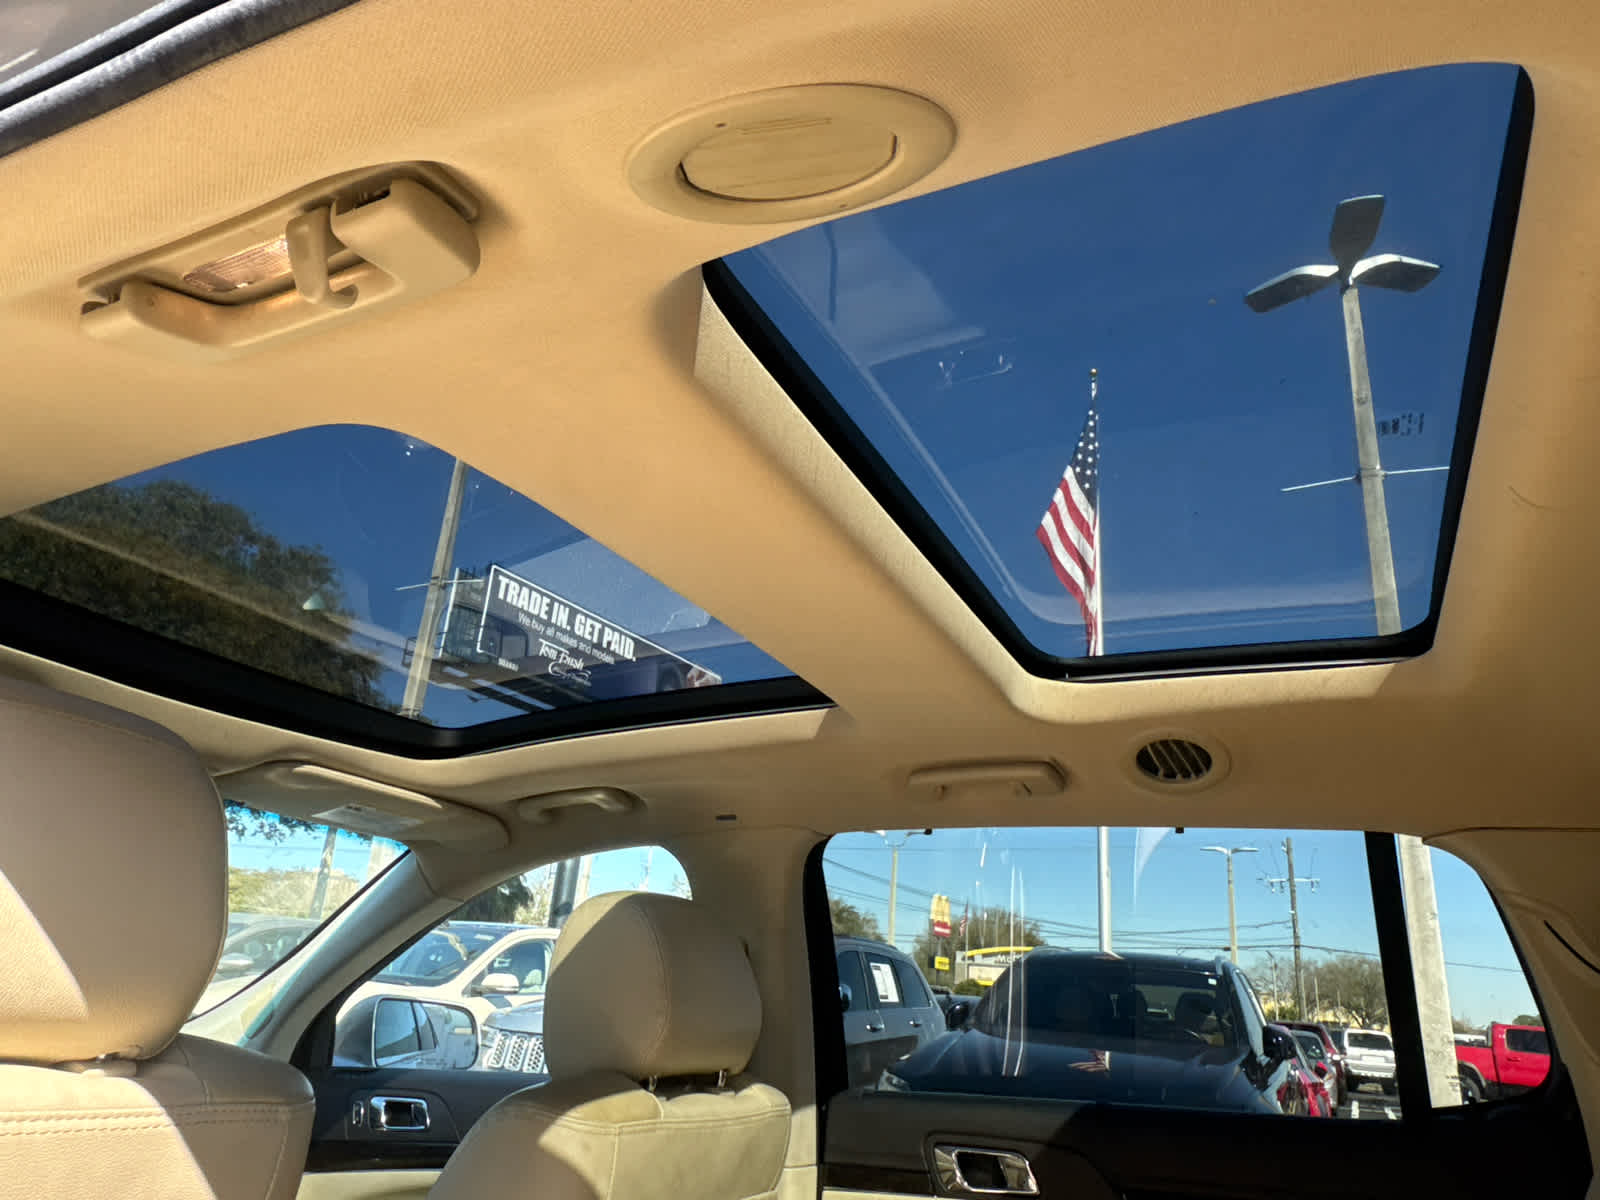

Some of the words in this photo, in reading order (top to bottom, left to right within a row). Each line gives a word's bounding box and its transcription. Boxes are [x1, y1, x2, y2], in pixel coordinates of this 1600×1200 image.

[498, 575, 550, 621] TRADE
[551, 602, 571, 631] IN.
[574, 613, 602, 644] GET
[602, 626, 637, 662] PAID.
[518, 611, 531, 627] We
[531, 619, 546, 635] buy
[546, 626, 555, 638] all
[555, 631, 578, 649] makes
[578, 641, 591, 655] and
